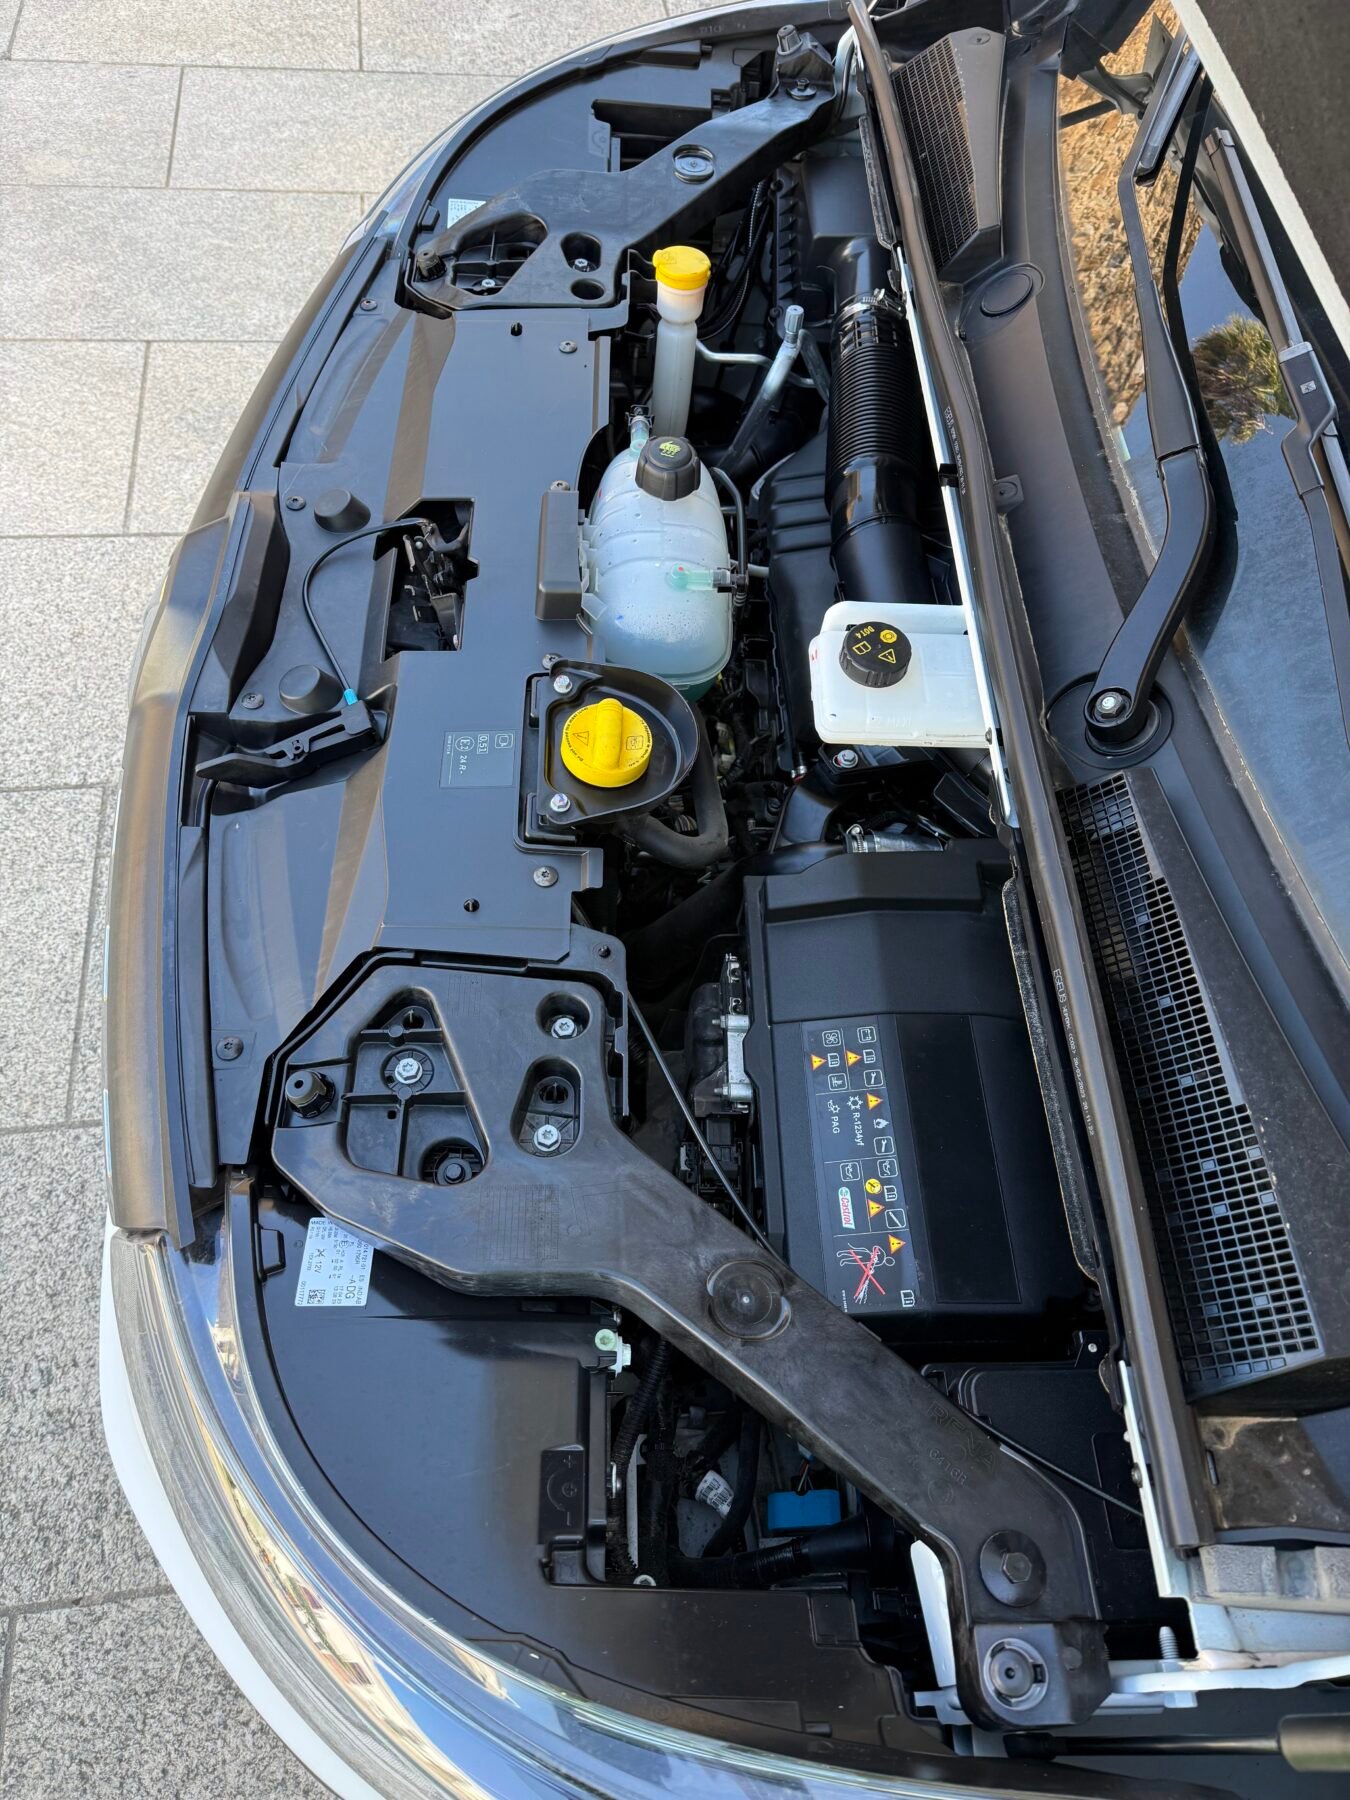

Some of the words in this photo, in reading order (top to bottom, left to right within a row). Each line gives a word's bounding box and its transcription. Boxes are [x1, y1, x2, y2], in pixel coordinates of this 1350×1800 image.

[1053, 968, 1067, 1003] EGEUS
[831, 1116, 840, 1134] PAG
[852, 1112, 865, 1147] R-1234yf
[840, 1197, 851, 1226] Castrol
